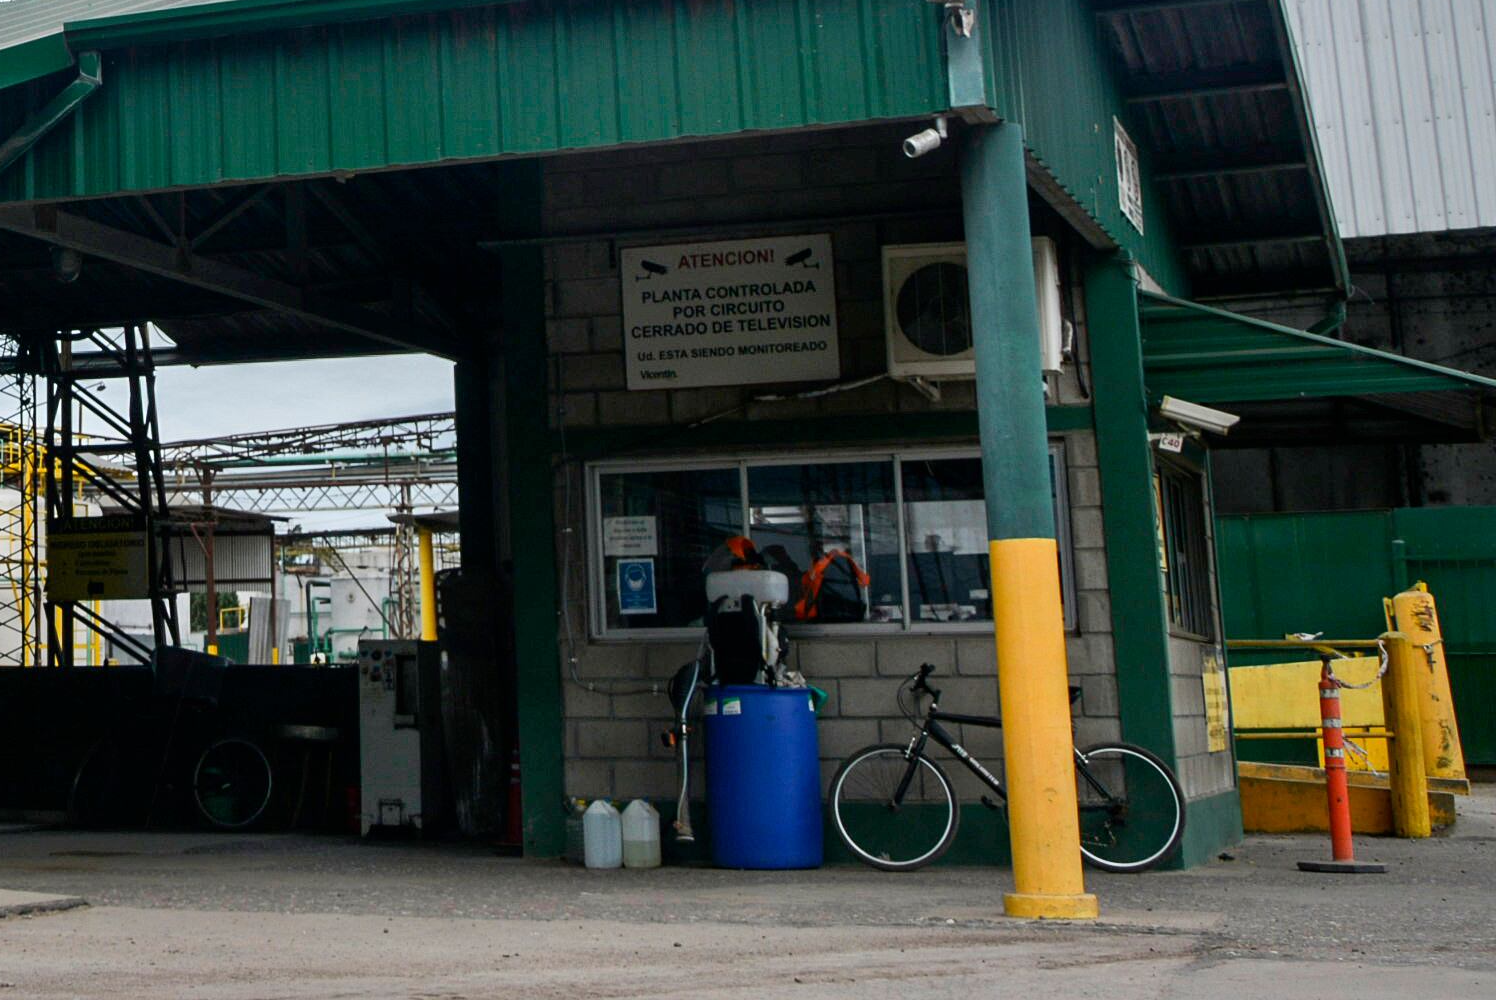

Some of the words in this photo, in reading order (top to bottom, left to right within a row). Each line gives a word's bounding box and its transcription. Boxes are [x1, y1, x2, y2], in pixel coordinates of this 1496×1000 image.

[678, 248, 775, 269] ATENCION!
[641, 288, 702, 304] PLANTA
[706, 280, 816, 300] CONTROLADA
[673, 304, 706, 319] POR
[710, 299, 785, 316] CIRCUITO
[631, 322, 708, 339] CERRADO
[712, 320, 734, 334] DE
[738, 314, 831, 333] TELEVISION
[659, 349, 688, 360] ESTA
[691, 346, 735, 358] SIENDO
[738, 340, 828, 355] MONITOREADO
